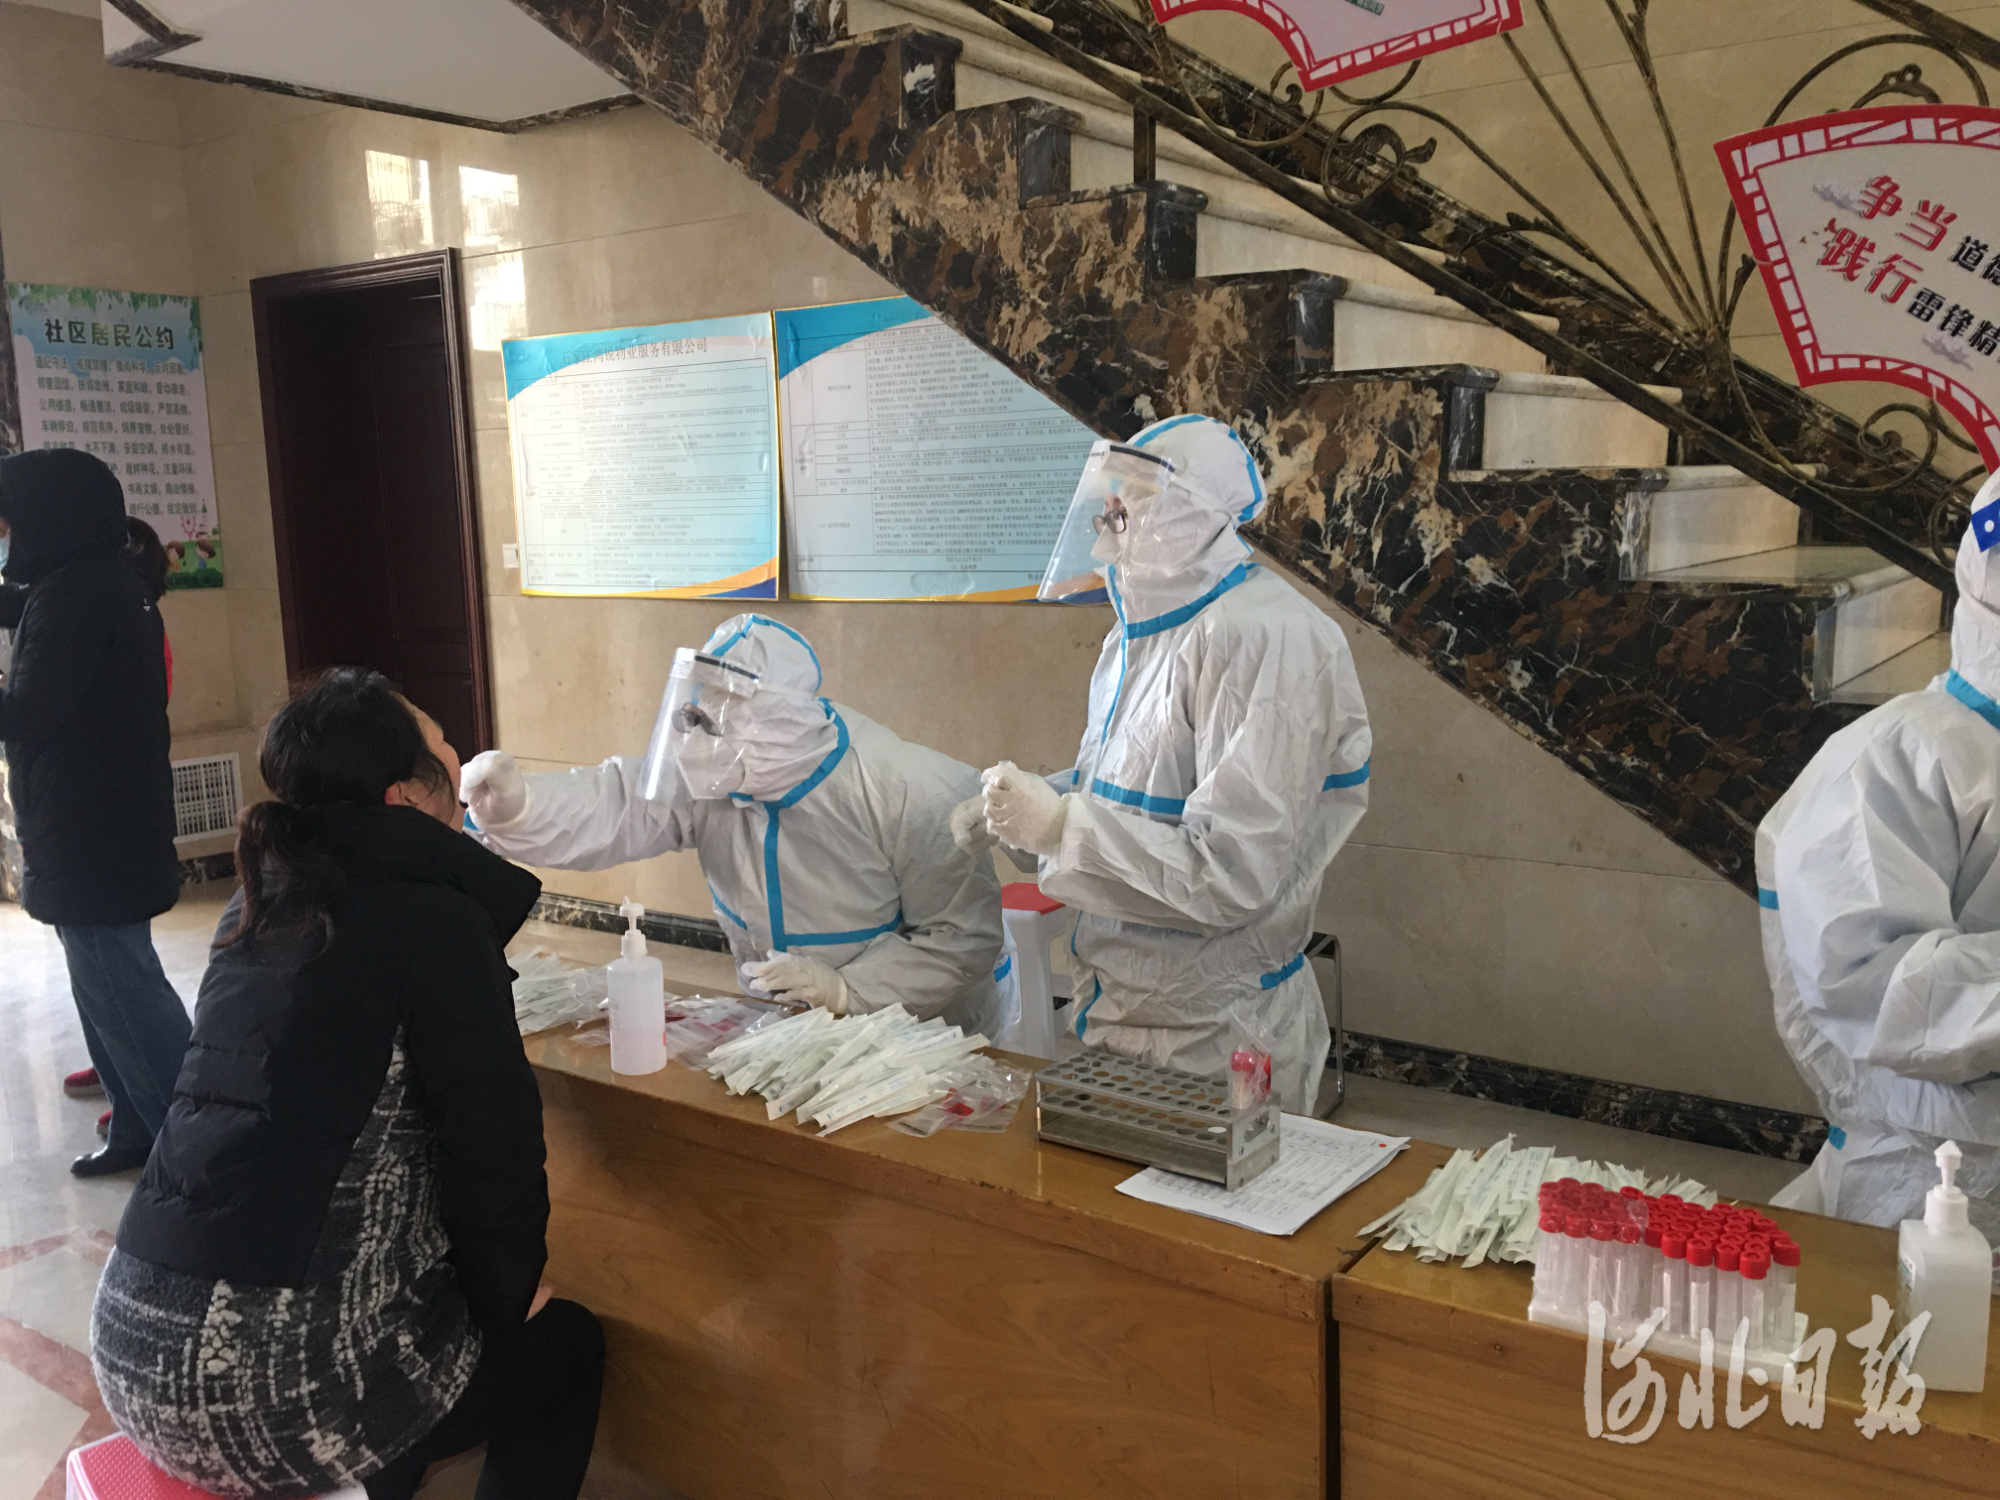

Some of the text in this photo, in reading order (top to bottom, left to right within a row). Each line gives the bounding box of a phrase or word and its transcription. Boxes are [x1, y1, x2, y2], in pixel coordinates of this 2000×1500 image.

[1858, 174, 1957, 252] 争当
[1819, 226, 2000, 358] 践行 雷锋精
[44, 318, 175, 350] 社区居民公约
